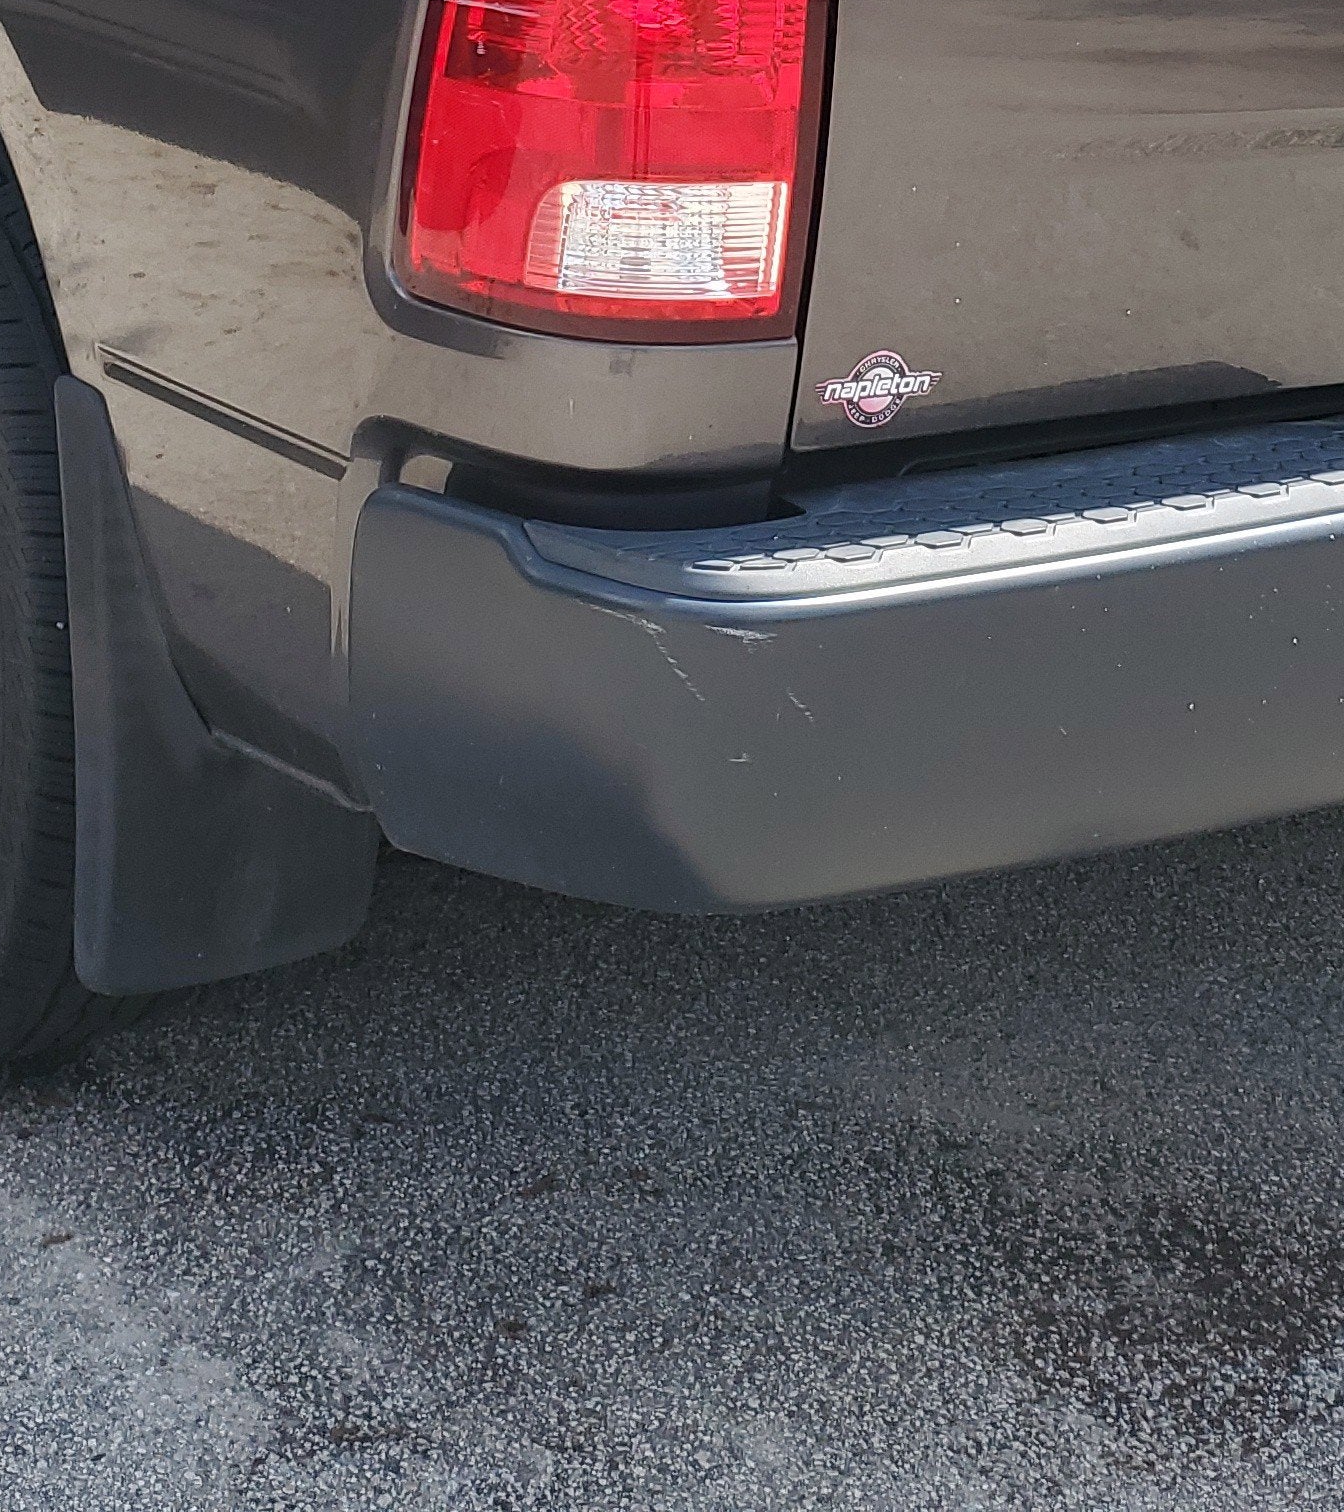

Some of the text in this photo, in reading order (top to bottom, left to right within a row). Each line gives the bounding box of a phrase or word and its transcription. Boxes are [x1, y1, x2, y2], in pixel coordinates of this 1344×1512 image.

[858, 356, 900, 373] CHRYSLER
[823, 373, 931, 403] napleton
[847, 398, 902, 424] JEEP DODGE
